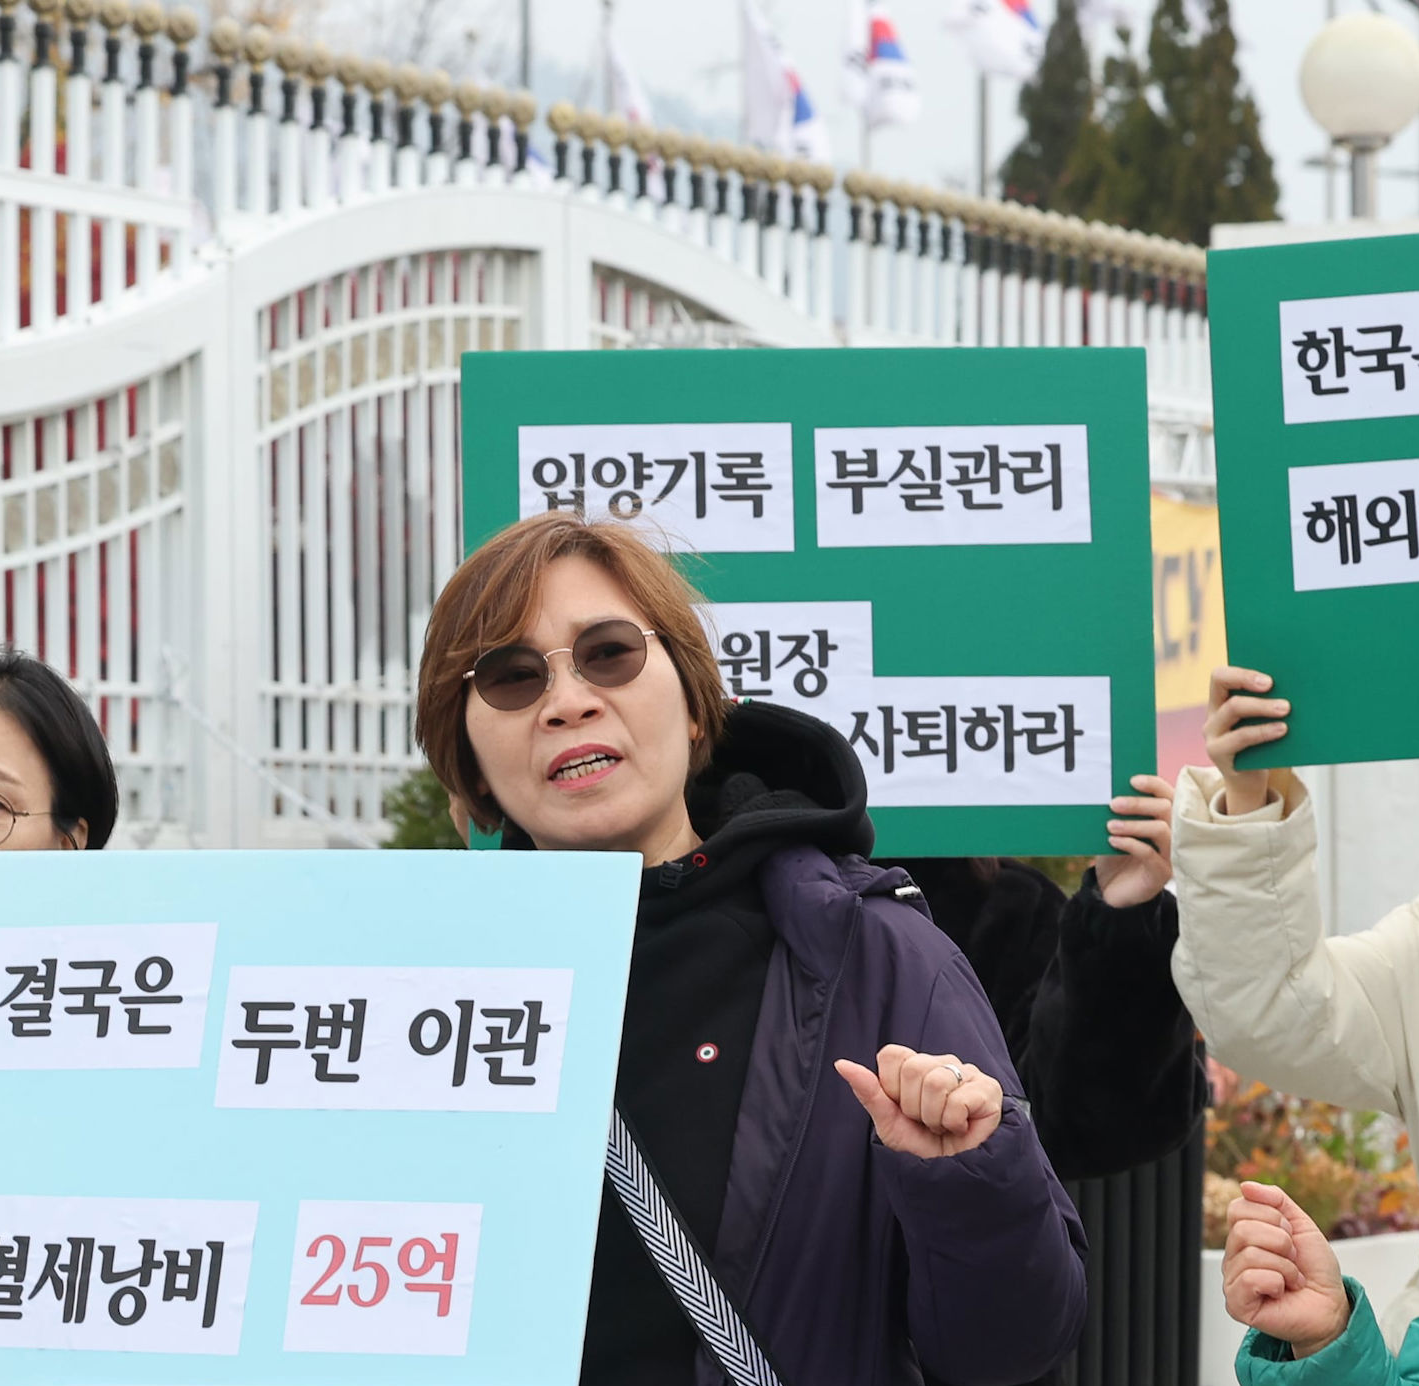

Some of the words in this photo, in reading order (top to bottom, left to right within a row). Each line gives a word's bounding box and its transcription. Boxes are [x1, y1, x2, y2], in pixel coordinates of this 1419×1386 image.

[532, 451, 773, 520] 입양기록
[827, 445, 1062, 514] 부실관리
[849, 705, 1083, 778] 사퇴하라
[232, 999, 366, 1084] 두번
[409, 1000, 550, 1086] 이관
[302, 1234, 458, 1316] 25억
